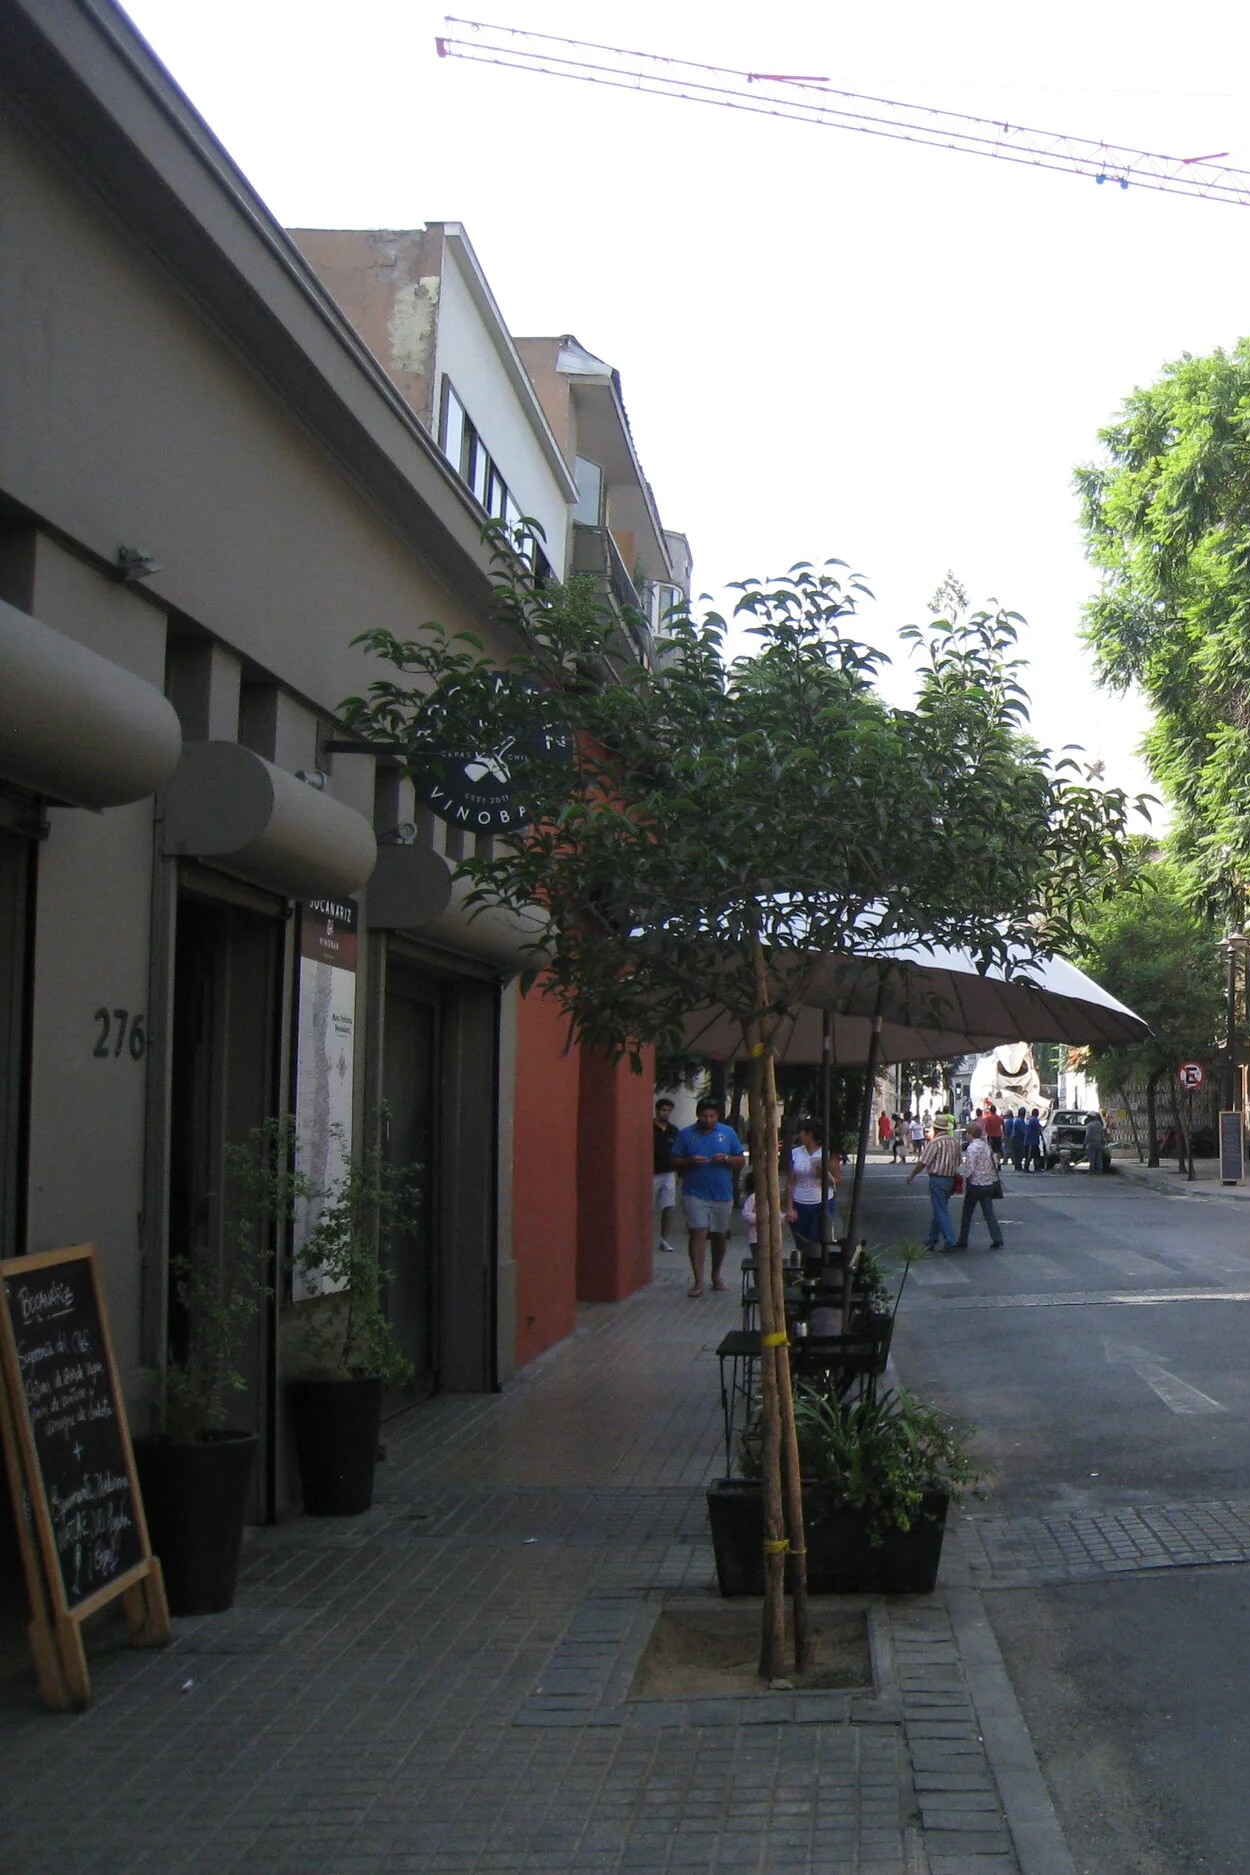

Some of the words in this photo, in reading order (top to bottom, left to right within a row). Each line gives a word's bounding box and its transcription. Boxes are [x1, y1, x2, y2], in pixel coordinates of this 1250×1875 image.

[507, 753, 530, 761] CHIL
[93, 1007, 145, 1060] 276
[1186, 1067, 1198, 1084] E
